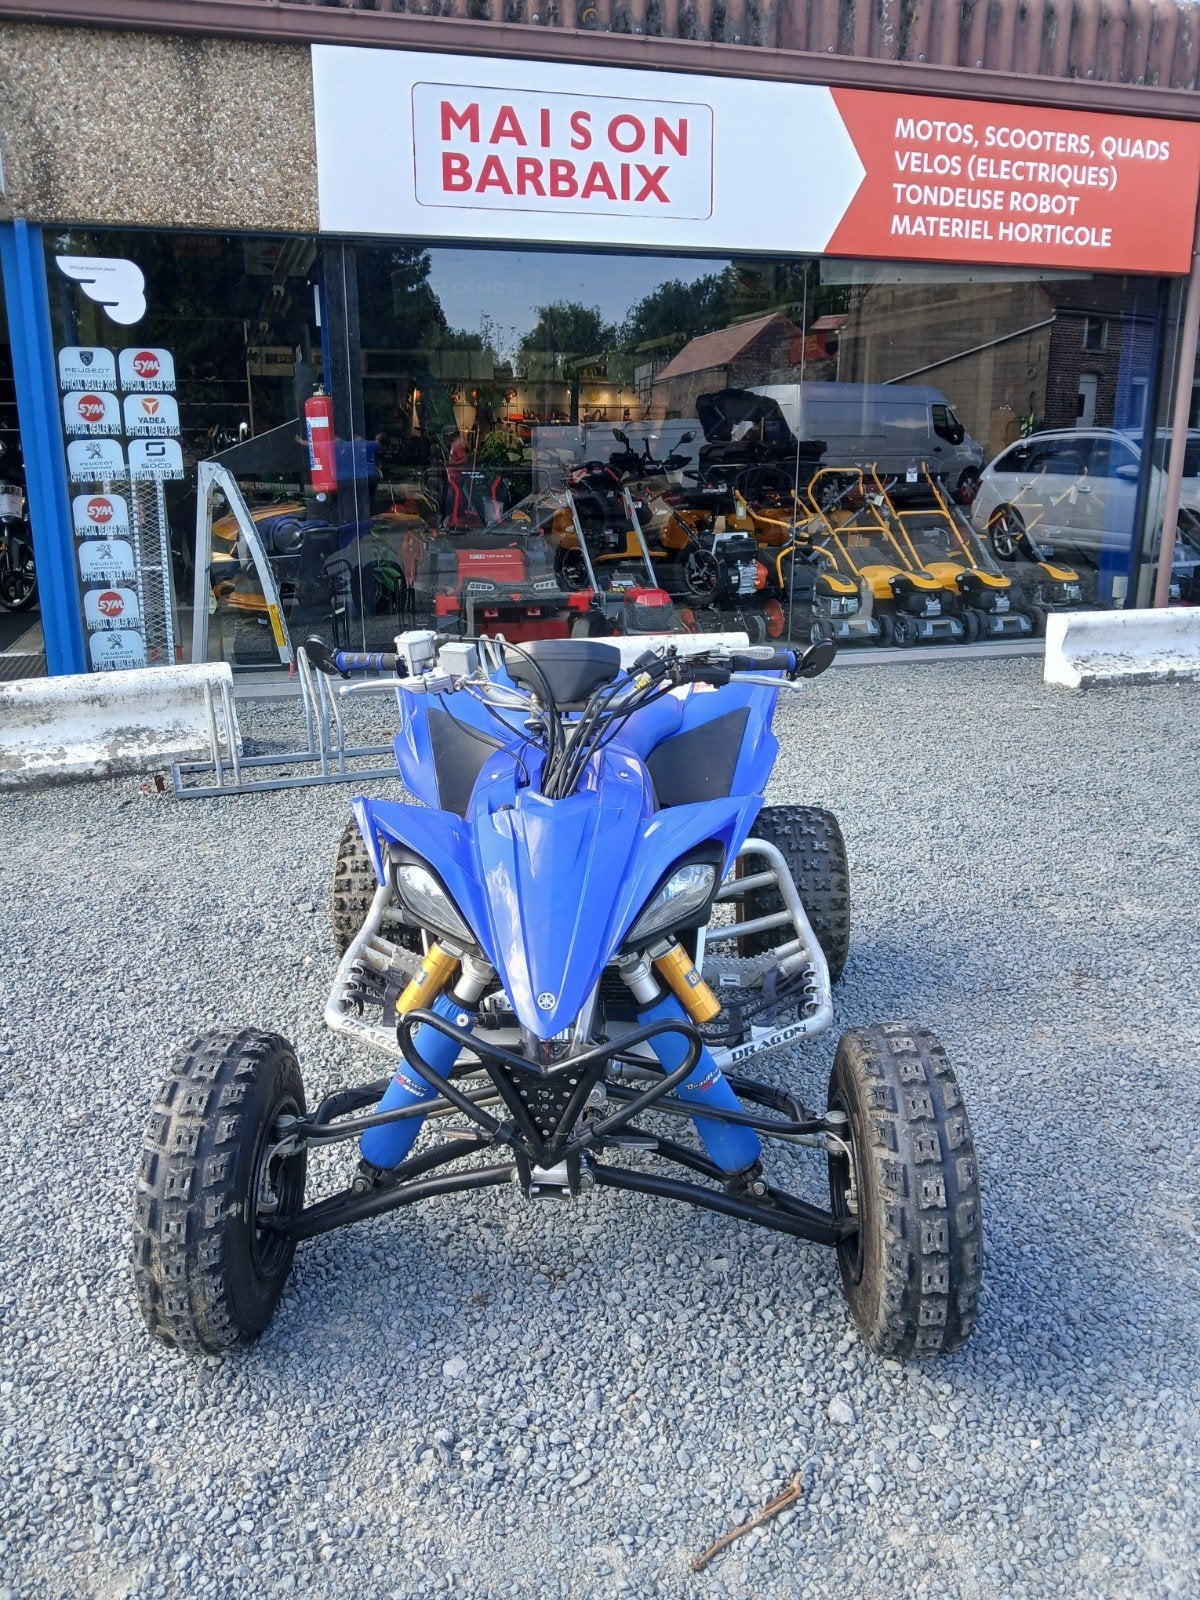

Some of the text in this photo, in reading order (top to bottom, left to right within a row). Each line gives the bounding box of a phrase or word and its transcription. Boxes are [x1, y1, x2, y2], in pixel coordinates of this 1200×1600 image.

[440, 100, 688, 156] MAISON
[894, 117, 1170, 161] MOTOS, SCOOTERS, QUADS
[441, 151, 671, 203] BARBAIX
[894, 150, 1118, 191] VELOS (ELECTRIQUES)
[892, 182, 1080, 215] TONDEUSE ROBOT
[890, 214, 1113, 247] MATERIEL HORTICOLE
[134, 360, 160, 373] SYM
[61, 379, 83, 390] OFFICIAL
[78, 403, 105, 416] SYM
[137, 416, 167, 424] YADEA
[126, 425, 147, 436] OFFICIAL
[87, 505, 113, 518] SYM
[98, 600, 124, 612] SYM
[342, 1018, 401, 1053] DRAGO
[731, 1023, 807, 1062] DRAGON
